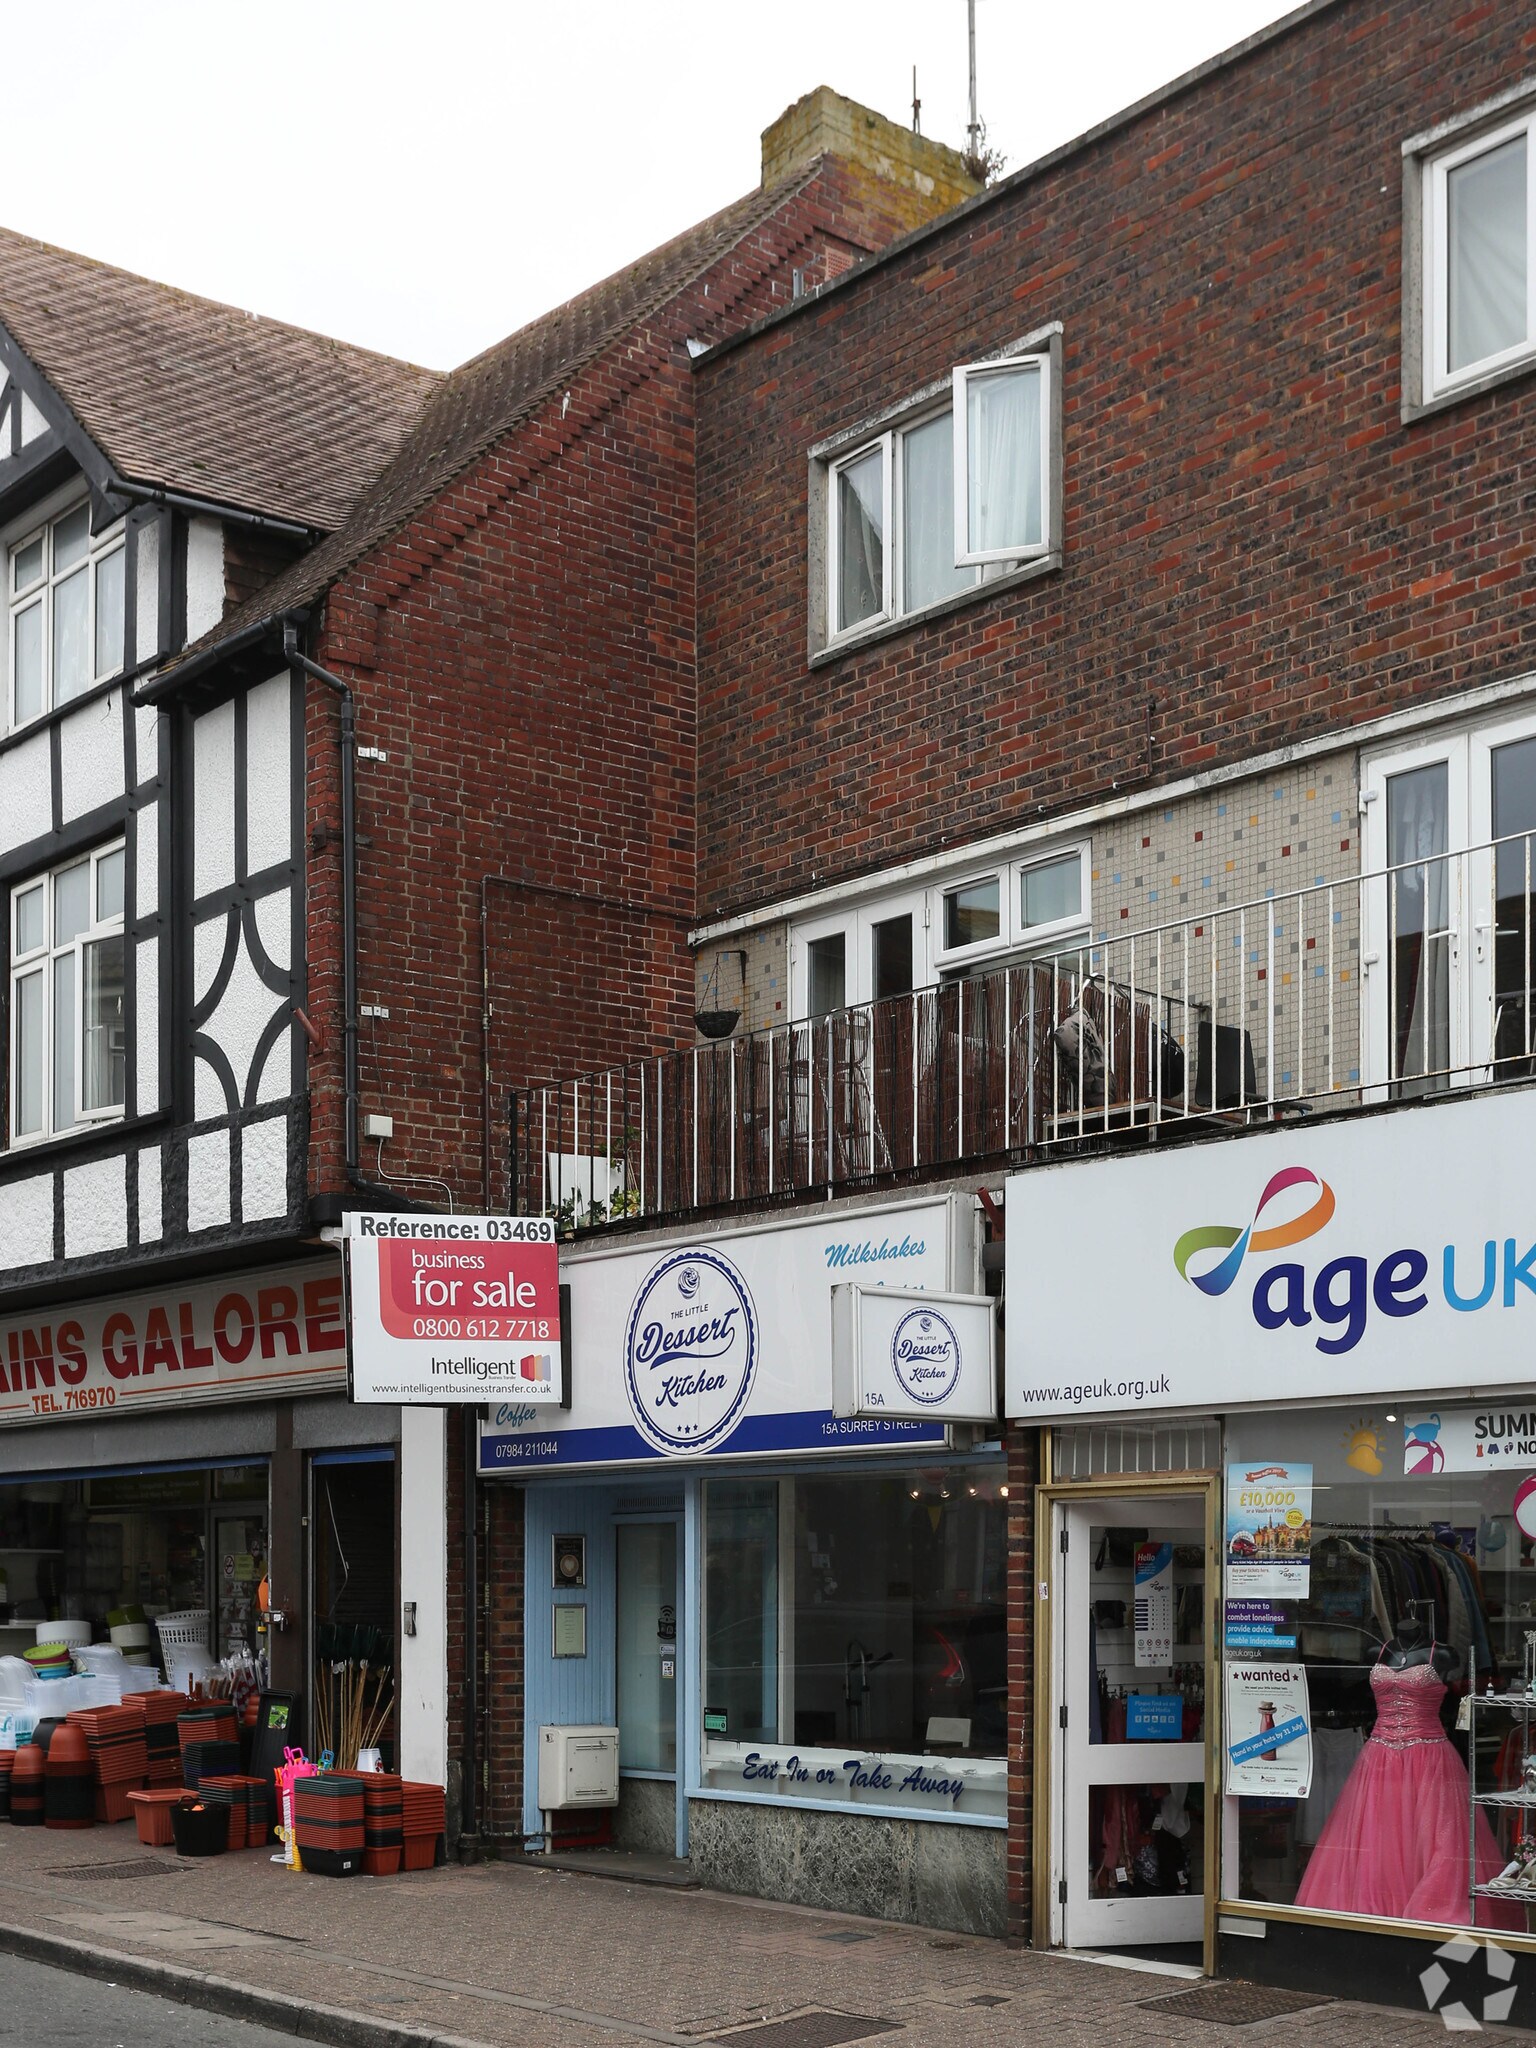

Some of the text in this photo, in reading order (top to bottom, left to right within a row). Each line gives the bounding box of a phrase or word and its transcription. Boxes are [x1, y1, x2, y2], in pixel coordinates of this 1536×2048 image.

[361, 1216, 551, 1241] Reference: 03469
[412, 1249, 485, 1269] business
[825, 1234, 926, 1267] Milkshakes
[412, 1270, 536, 1308] for sale
[1252, 1238, 1536, 1355] age UK
[671, 1304, 709, 1320] THE LITTLE
[102, 1276, 345, 1379] GALORE
[413, 1319, 549, 1338] 0800 612 7718
[636, 1308, 739, 1364] Dessert
[898, 1339, 951, 1359] Dessert
[432, 1357, 516, 1380] Intelligent
[909, 1367, 946, 1382] Kitchen
[372, 1383, 551, 1395] www.intelligentbusinesstransfer.co.uk
[655, 1369, 727, 1407] Kitchen
[1023, 1374, 1170, 1404] www.ageuk.org.uk
[32, 1386, 116, 1413] TEL. 716970
[865, 1392, 885, 1405] 15A
[495, 1402, 537, 1428] Coffee
[821, 1422, 838, 1435] 15A
[840, 1420, 881, 1433] SURREY
[496, 1442, 558, 1458] 07984 211044
[1240, 1491, 1296, 1507] £10,000
[1137, 1553, 1156, 1561] Hello
[1227, 1601, 1270, 1610] We're here to
[1227, 1613, 1285, 1622] combat loneliness
[1227, 1625, 1273, 1633] provide advice
[1227, 1636, 1295, 1646] enable independence
[1241, 1669, 1291, 1682] wanted
[1232, 1748, 1247, 1758] Hand
[1252, 1741, 1263, 1752] your
[1262, 1734, 1275, 1745] hats
[1275, 1731, 1283, 1739] by
[1283, 1728, 1290, 1736] 31
[1291, 1722, 1304, 1733] July!
[742, 1752, 965, 1803] Eat In or Take Away
